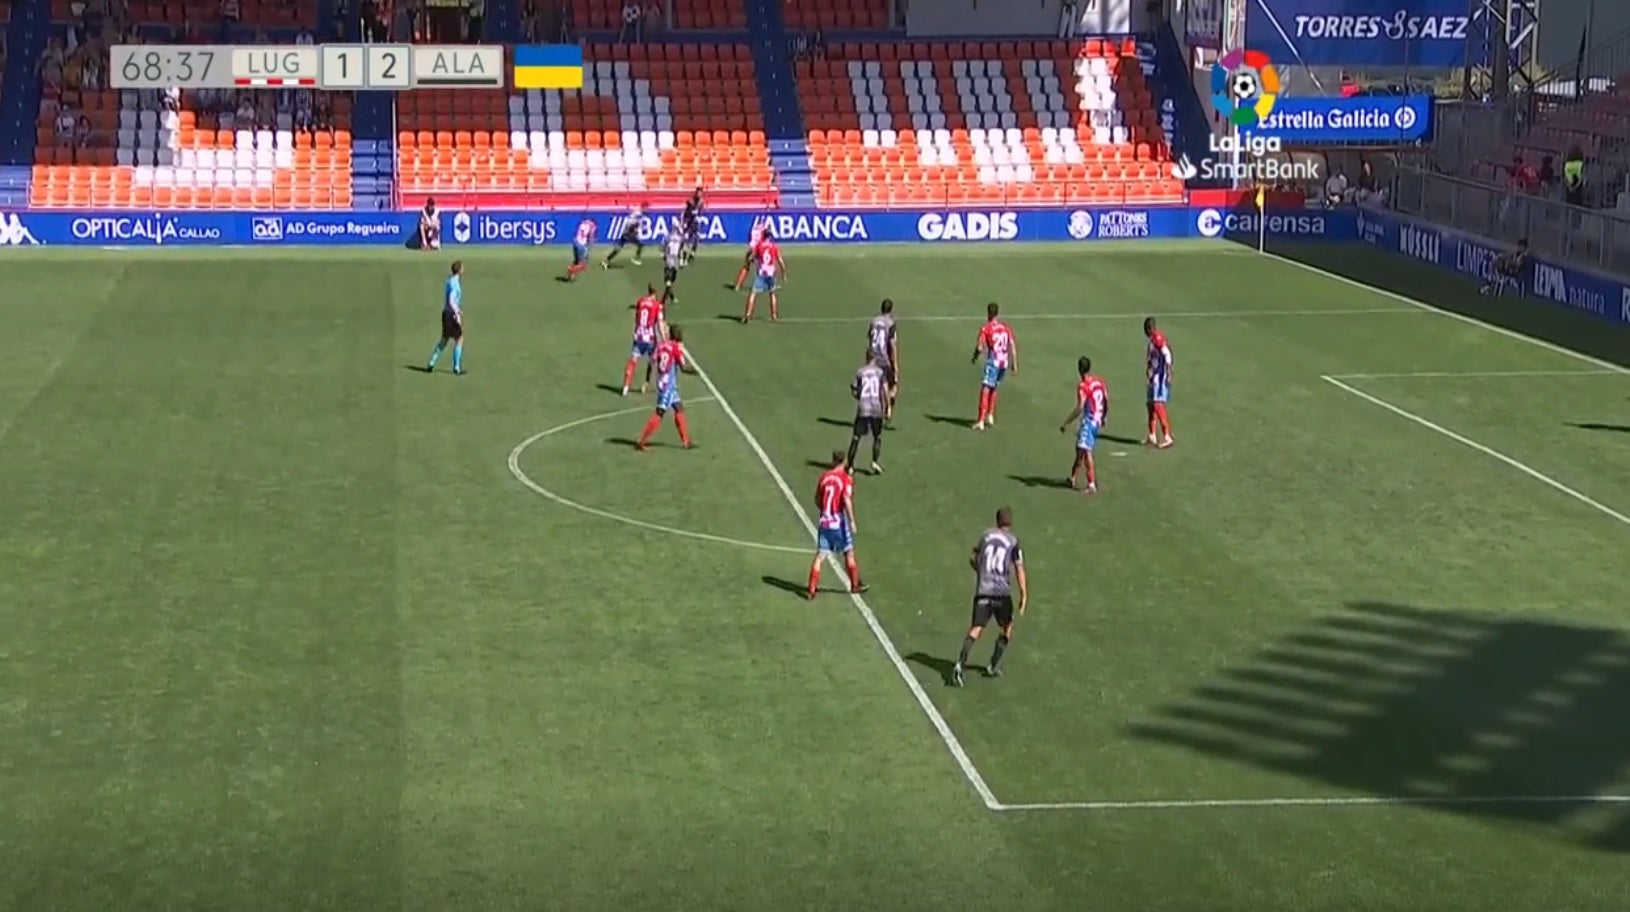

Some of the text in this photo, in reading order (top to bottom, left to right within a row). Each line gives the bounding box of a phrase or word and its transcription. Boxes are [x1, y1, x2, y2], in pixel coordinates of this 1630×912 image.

[1295, 16, 1380, 38] TORRES
[1406, 16, 1469, 39] SAEZ
[1257, 107, 1390, 129] Estrella Galicia
[179, 228, 220, 239] CALLAO
[286, 221, 400, 237] AD Grupo Regueira
[479, 216, 556, 243] ibersys
[637, 214, 727, 240] BACA
[762, 214, 868, 239] ABANCA
[917, 212, 1019, 240] GADIS
[763, 248, 772, 265] 6
[1569, 286, 1605, 315] natura
[992, 332, 1008, 352] 20
[861, 376, 880, 398] 20
[985, 544, 1006, 574] 14
